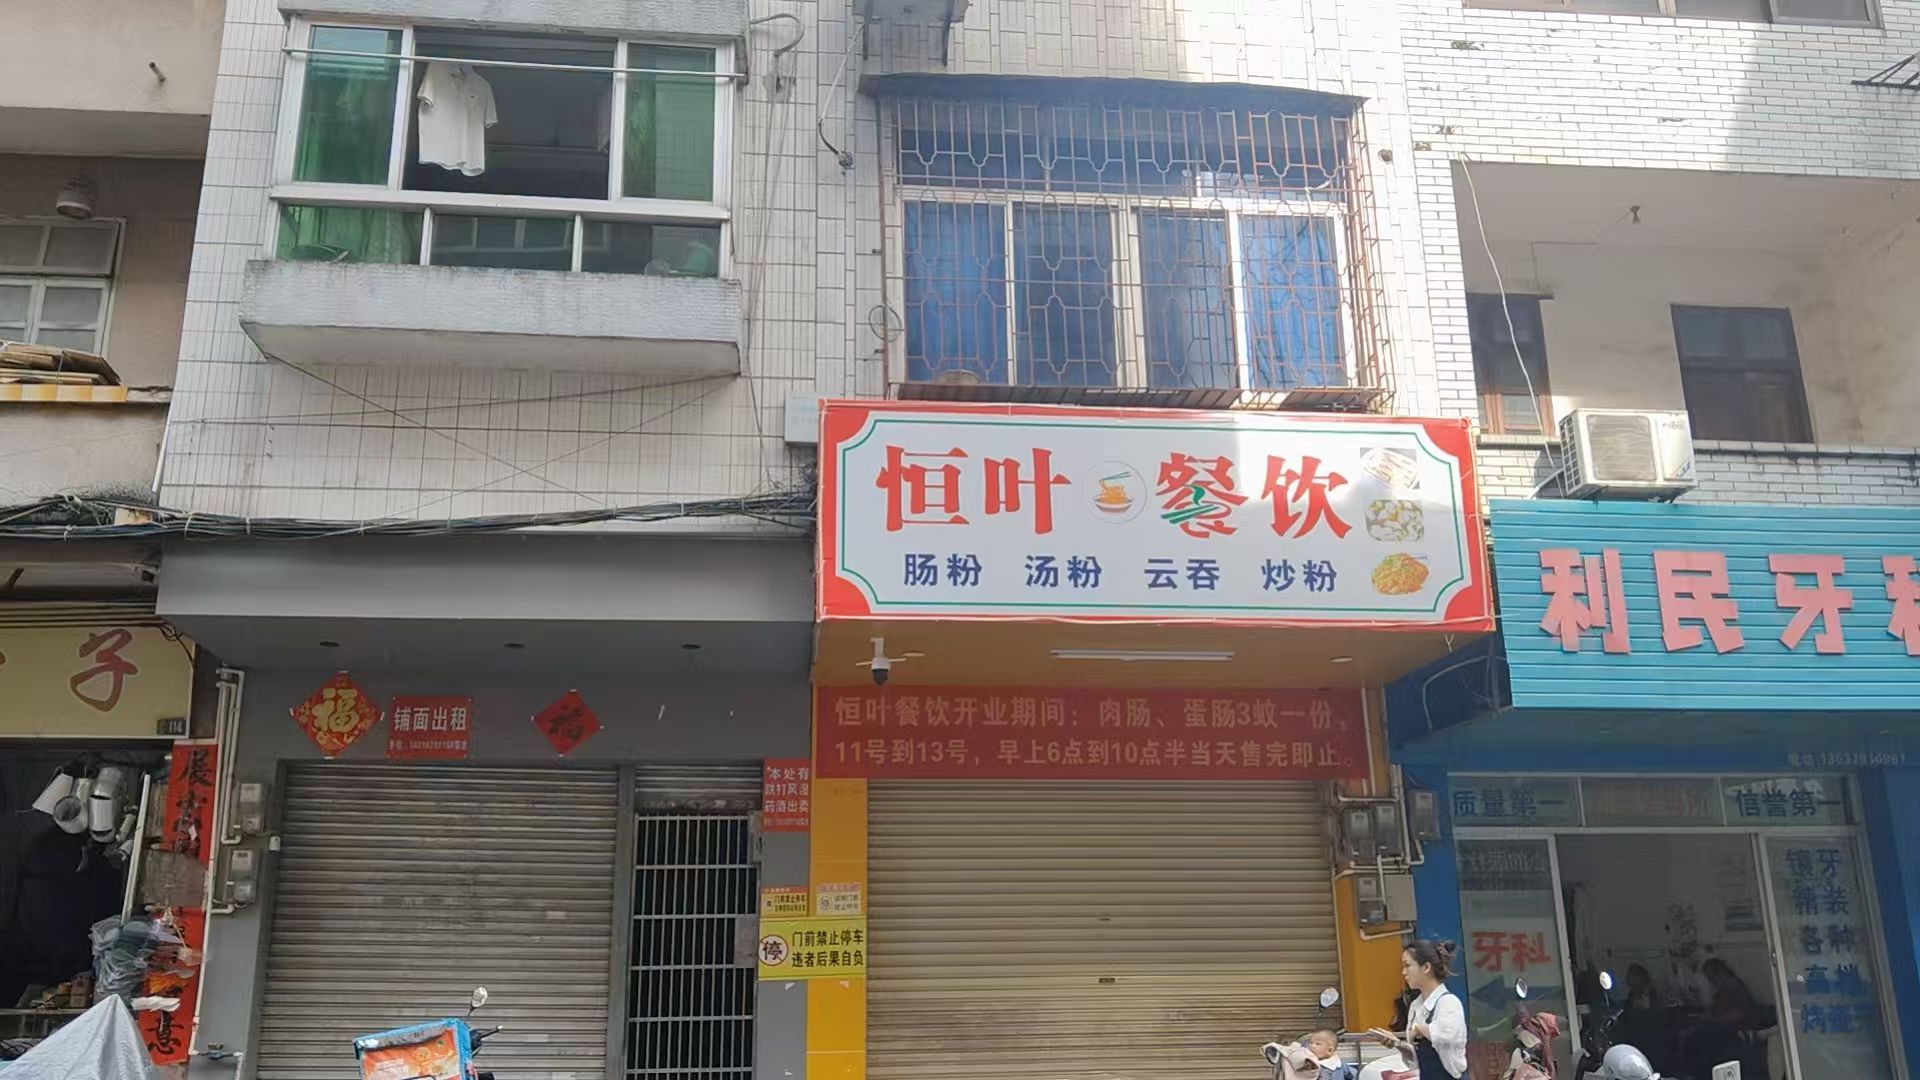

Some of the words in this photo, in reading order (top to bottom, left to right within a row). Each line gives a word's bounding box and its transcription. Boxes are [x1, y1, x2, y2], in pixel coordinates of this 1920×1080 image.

[876, 445, 1071, 535] 恒叶
[1155, 452, 1353, 539] 餐饮
[904, 553, 982, 587] 肠粉
[1025, 555, 1103, 589] 汤粉
[1144, 558, 1220, 591] 云吞
[1260, 558, 1337, 593] 炒粉
[394, 706, 467, 731] 铺面出租
[1453, 789, 1566, 818] 质量第一
[1736, 788, 1841, 818] 信誉第一
[762, 941, 783, 961] 停
[792, 929, 864, 947] 门前禁止停车
[1472, 931, 1552, 972] 牙科
[792, 950, 864, 968] 违者后果自负
